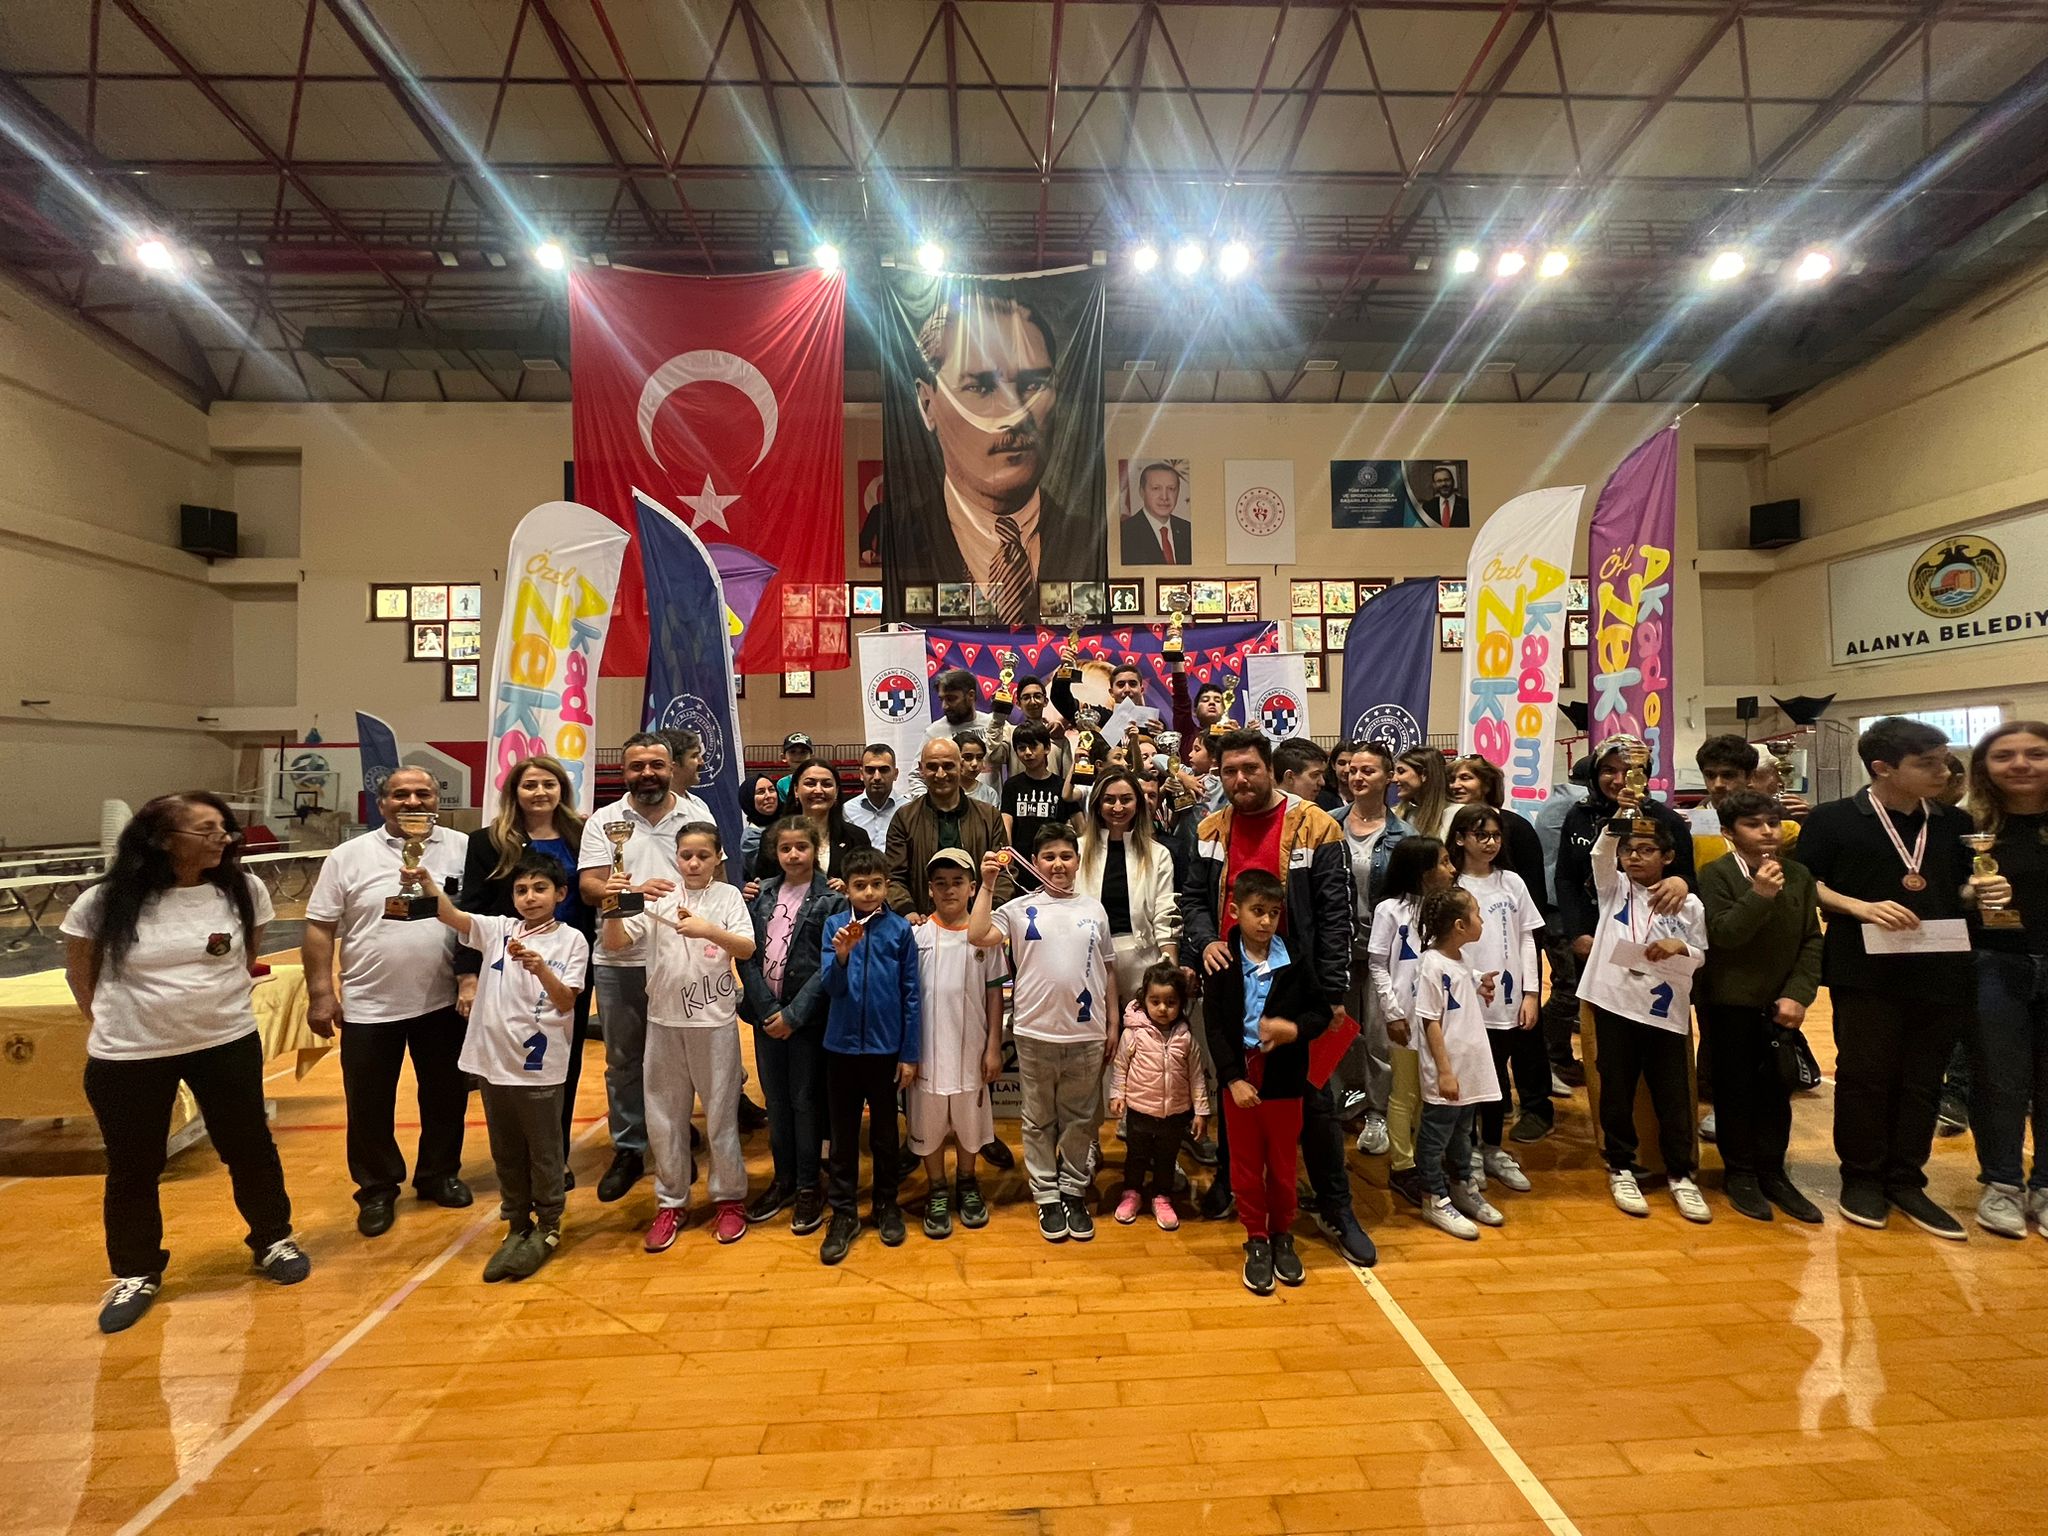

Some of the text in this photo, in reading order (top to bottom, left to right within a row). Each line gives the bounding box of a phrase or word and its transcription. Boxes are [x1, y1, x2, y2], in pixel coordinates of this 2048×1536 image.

[526, 549, 577, 587] Özel
[1482, 553, 1529, 581] Özel
[1846, 630, 1930, 655] ALANYA
